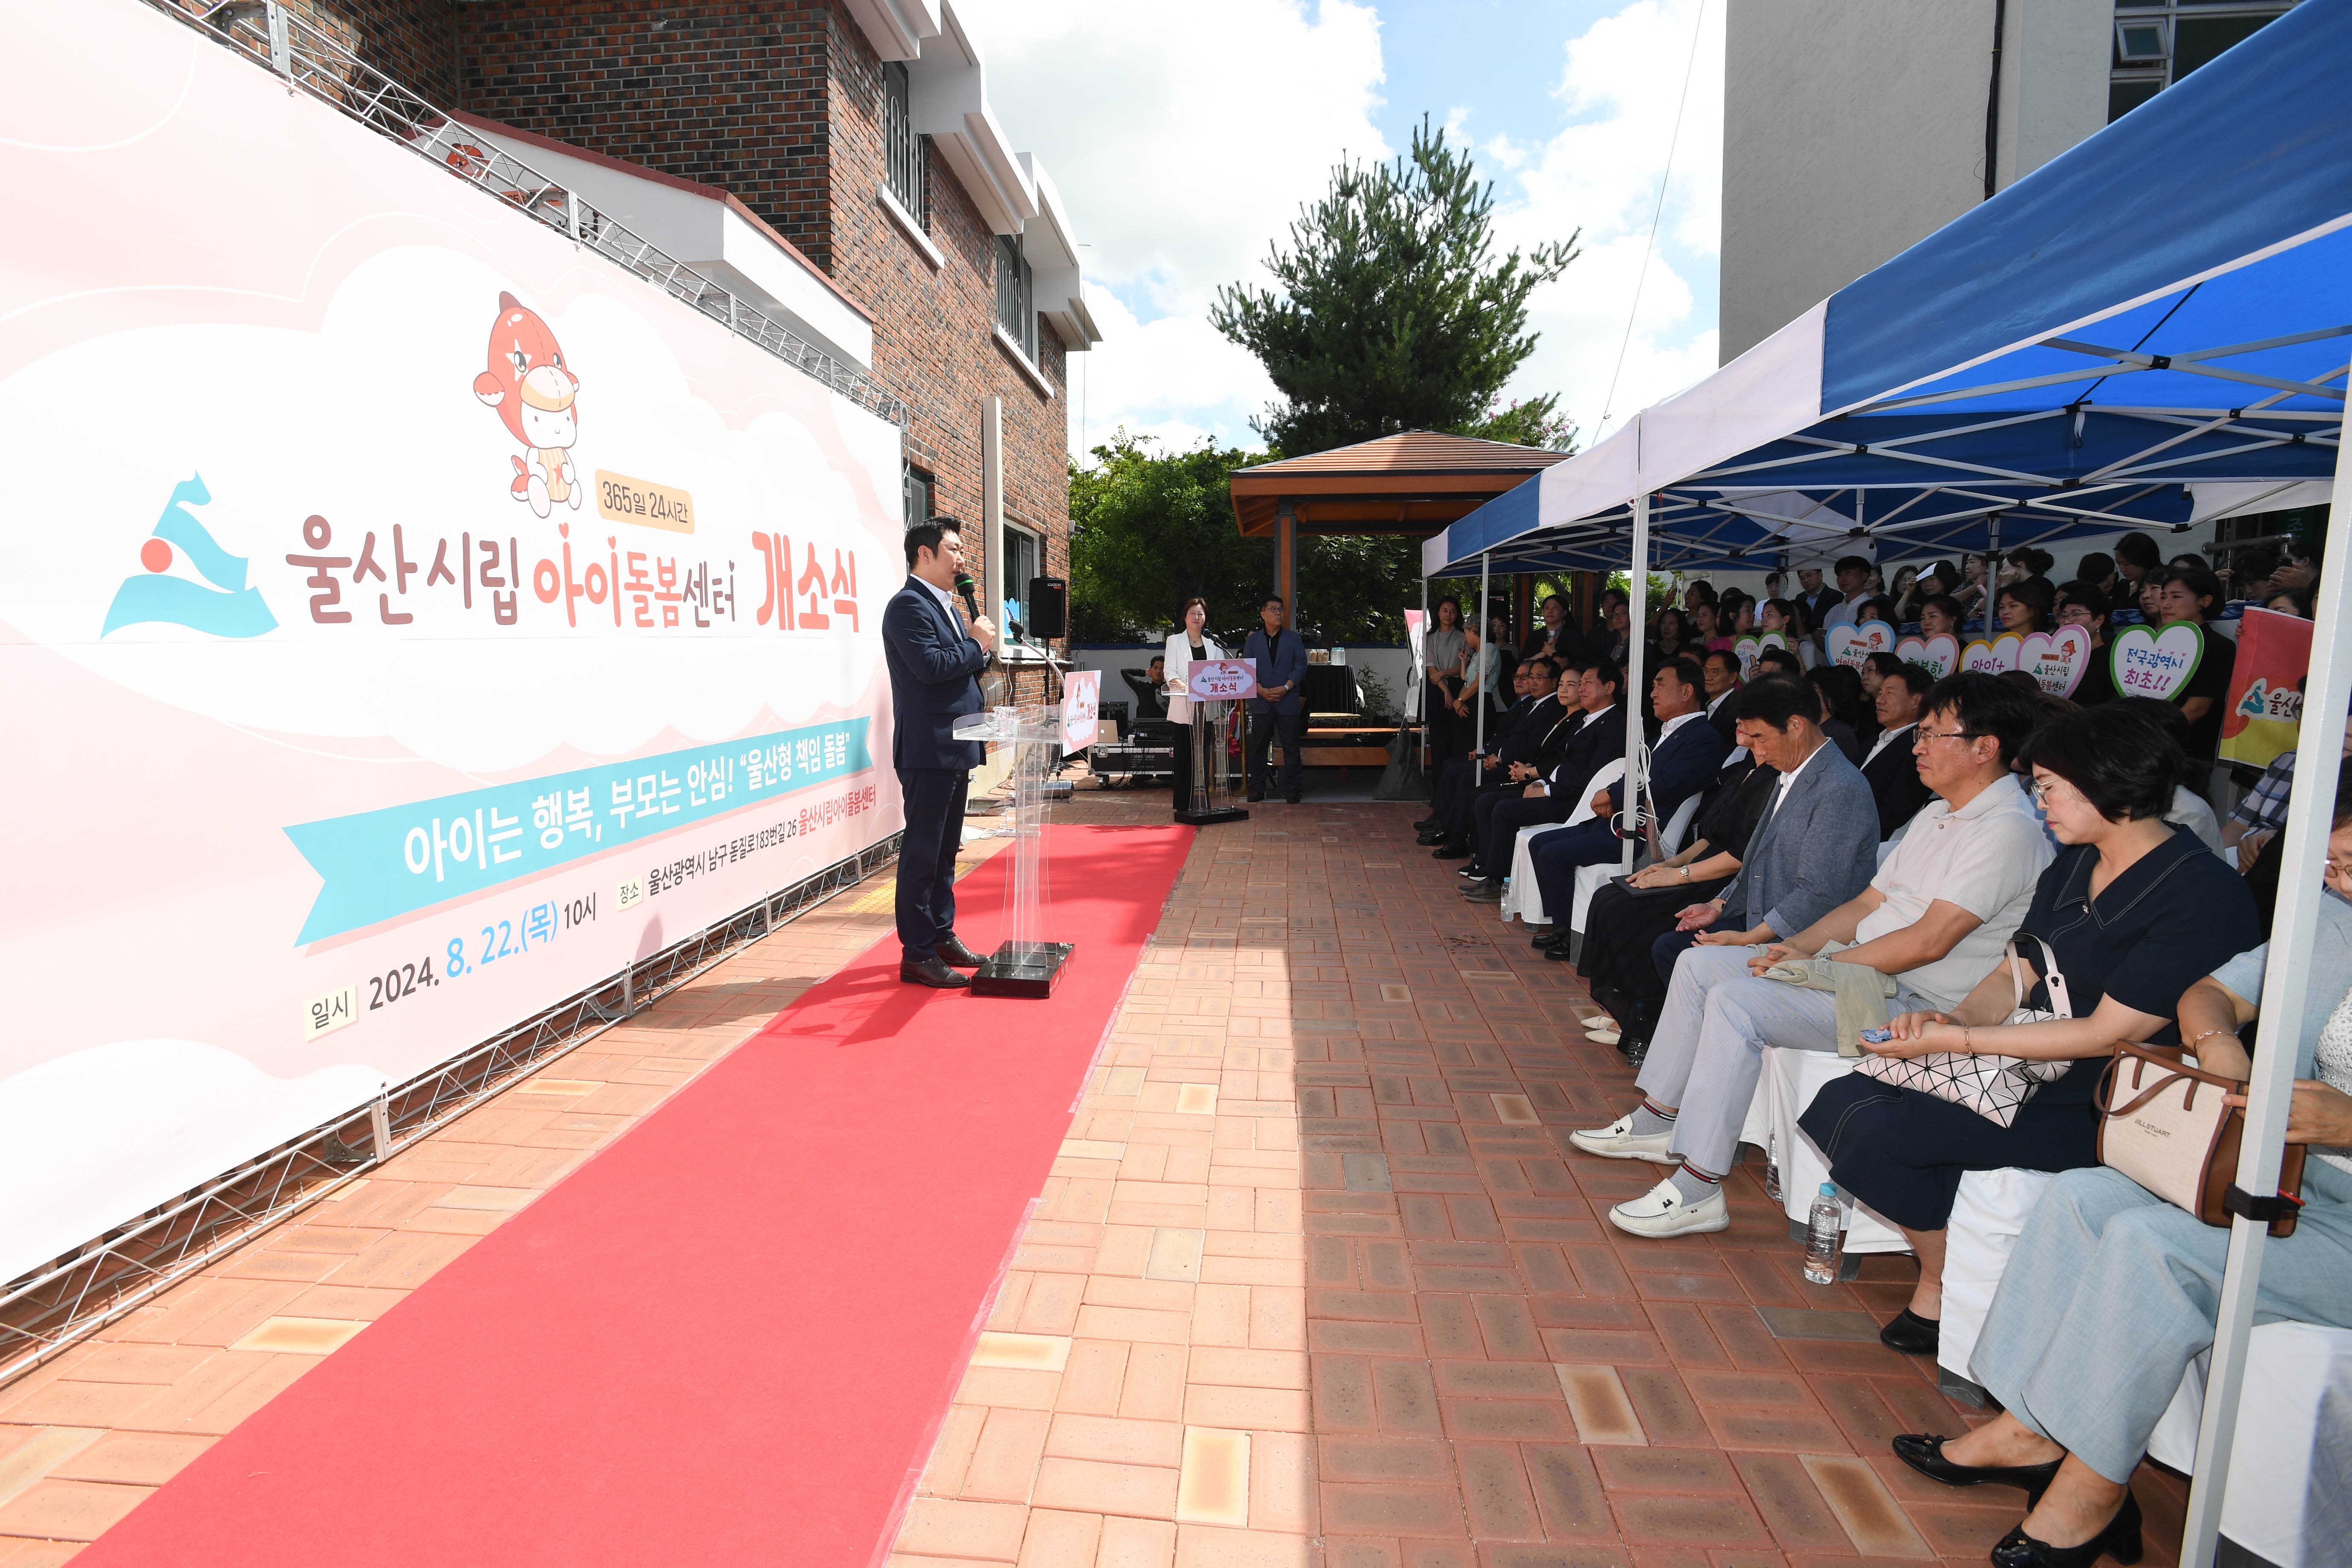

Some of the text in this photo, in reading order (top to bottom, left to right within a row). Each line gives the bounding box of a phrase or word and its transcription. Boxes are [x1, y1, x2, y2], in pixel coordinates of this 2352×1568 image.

[603, 481, 688, 524] 365일 24시간
[285, 514, 859, 633] 울산시립 아이돌봄센터 개소식
[1852, 648, 1871, 658] 울산시
[1971, 657, 2005, 671] 아이+
[2126, 648, 2183, 670] 전국광역시
[2044, 665, 2070, 677] 울산시립
[2124, 668, 2171, 691] 최초!!
[1210, 682, 1236, 692] 개소식
[1087, 701, 1096, 721] 개소식
[404, 807, 523, 882] 아이는
[532, 786, 602, 850] 행복,
[610, 770, 682, 829] 부모는
[687, 756, 733, 807] 안심!
[796, 736, 821, 775] 책임
[824, 731, 850, 770] 돌봄”
[620, 783, 876, 904] 장소 울산광역시 남구 돋질로183번길 26 울산시립아이돌봄센터
[311, 891, 596, 1030] 일시 2024. 8. 22.(목) 10시
